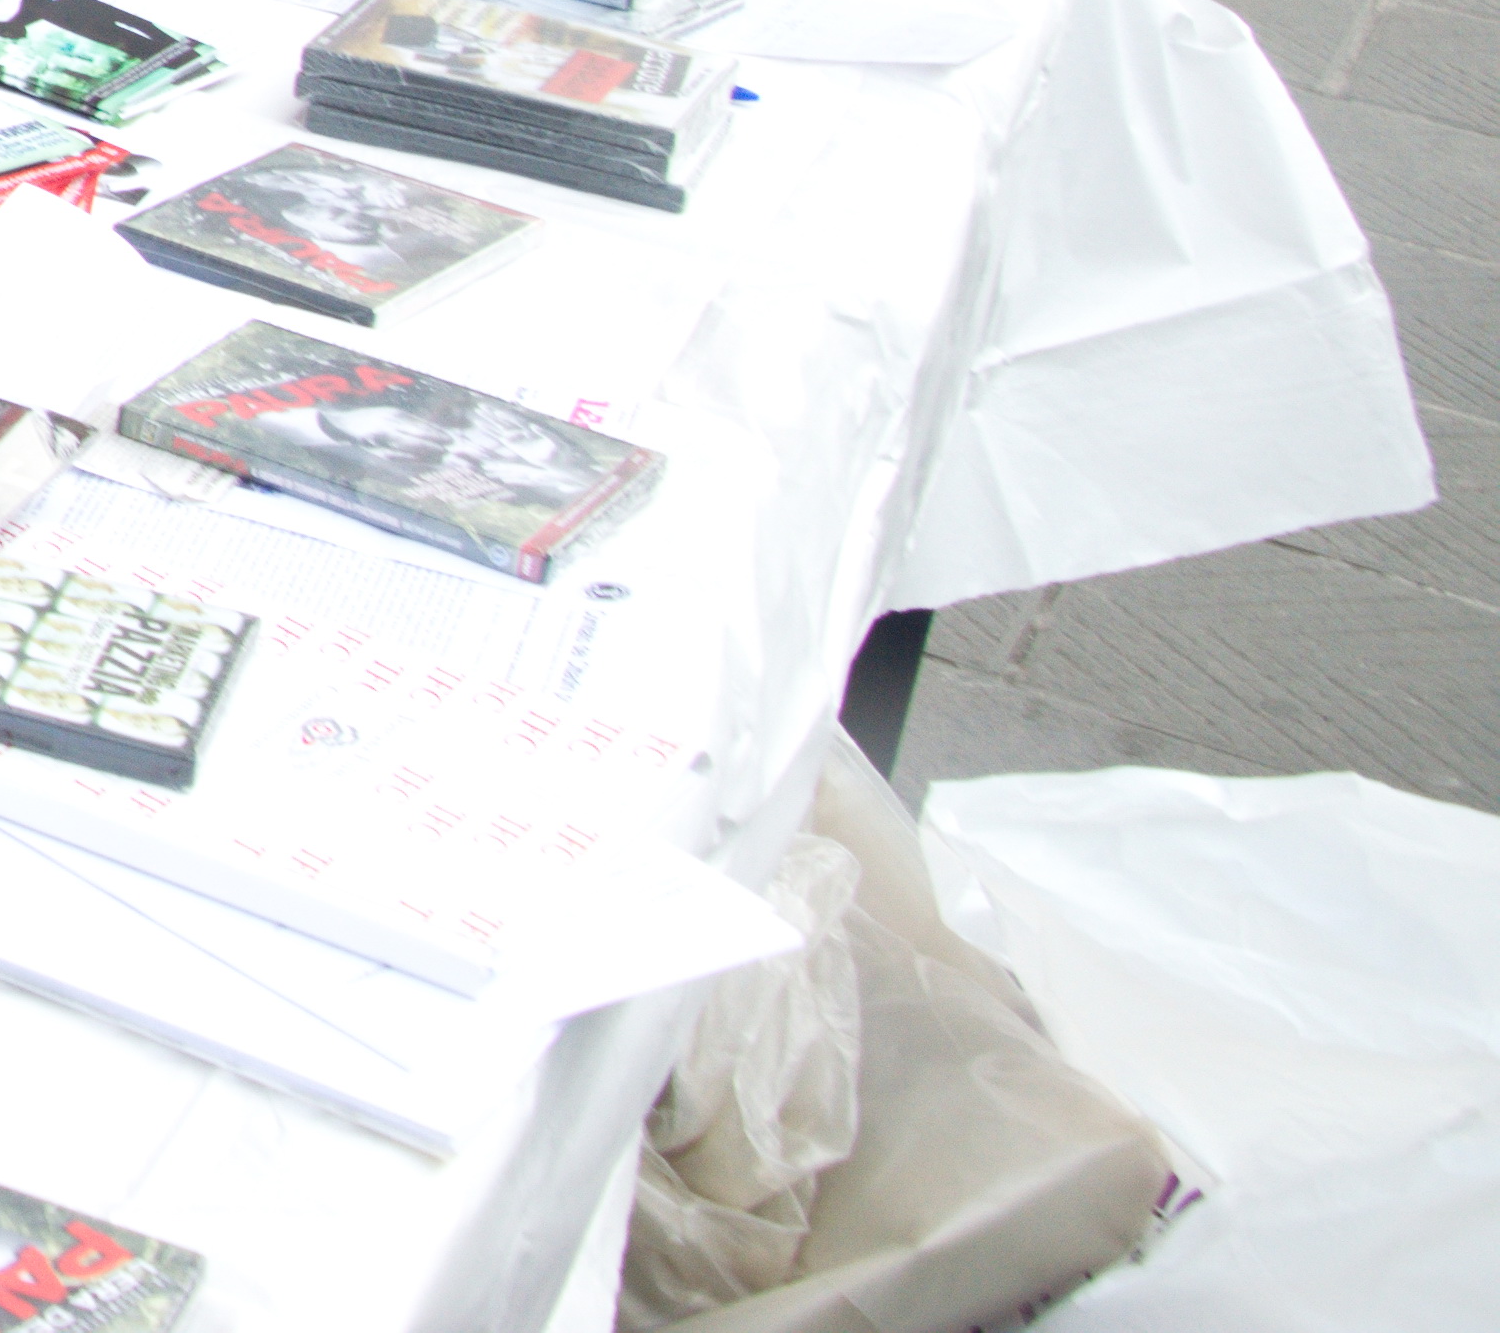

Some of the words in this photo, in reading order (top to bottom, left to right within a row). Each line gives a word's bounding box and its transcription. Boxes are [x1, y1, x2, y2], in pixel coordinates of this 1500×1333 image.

[172, 364, 415, 429] PAURA
[82, 610, 171, 697] PAZZIA
[409, 667, 466, 709] TFC
[504, 710, 561, 756] TFC
[567, 718, 625, 762] TFC
[375, 765, 434, 804] TFC
[407, 804, 467, 842] TFC
[473, 814, 532, 854] TFC
[540, 824, 600, 866] TFC
